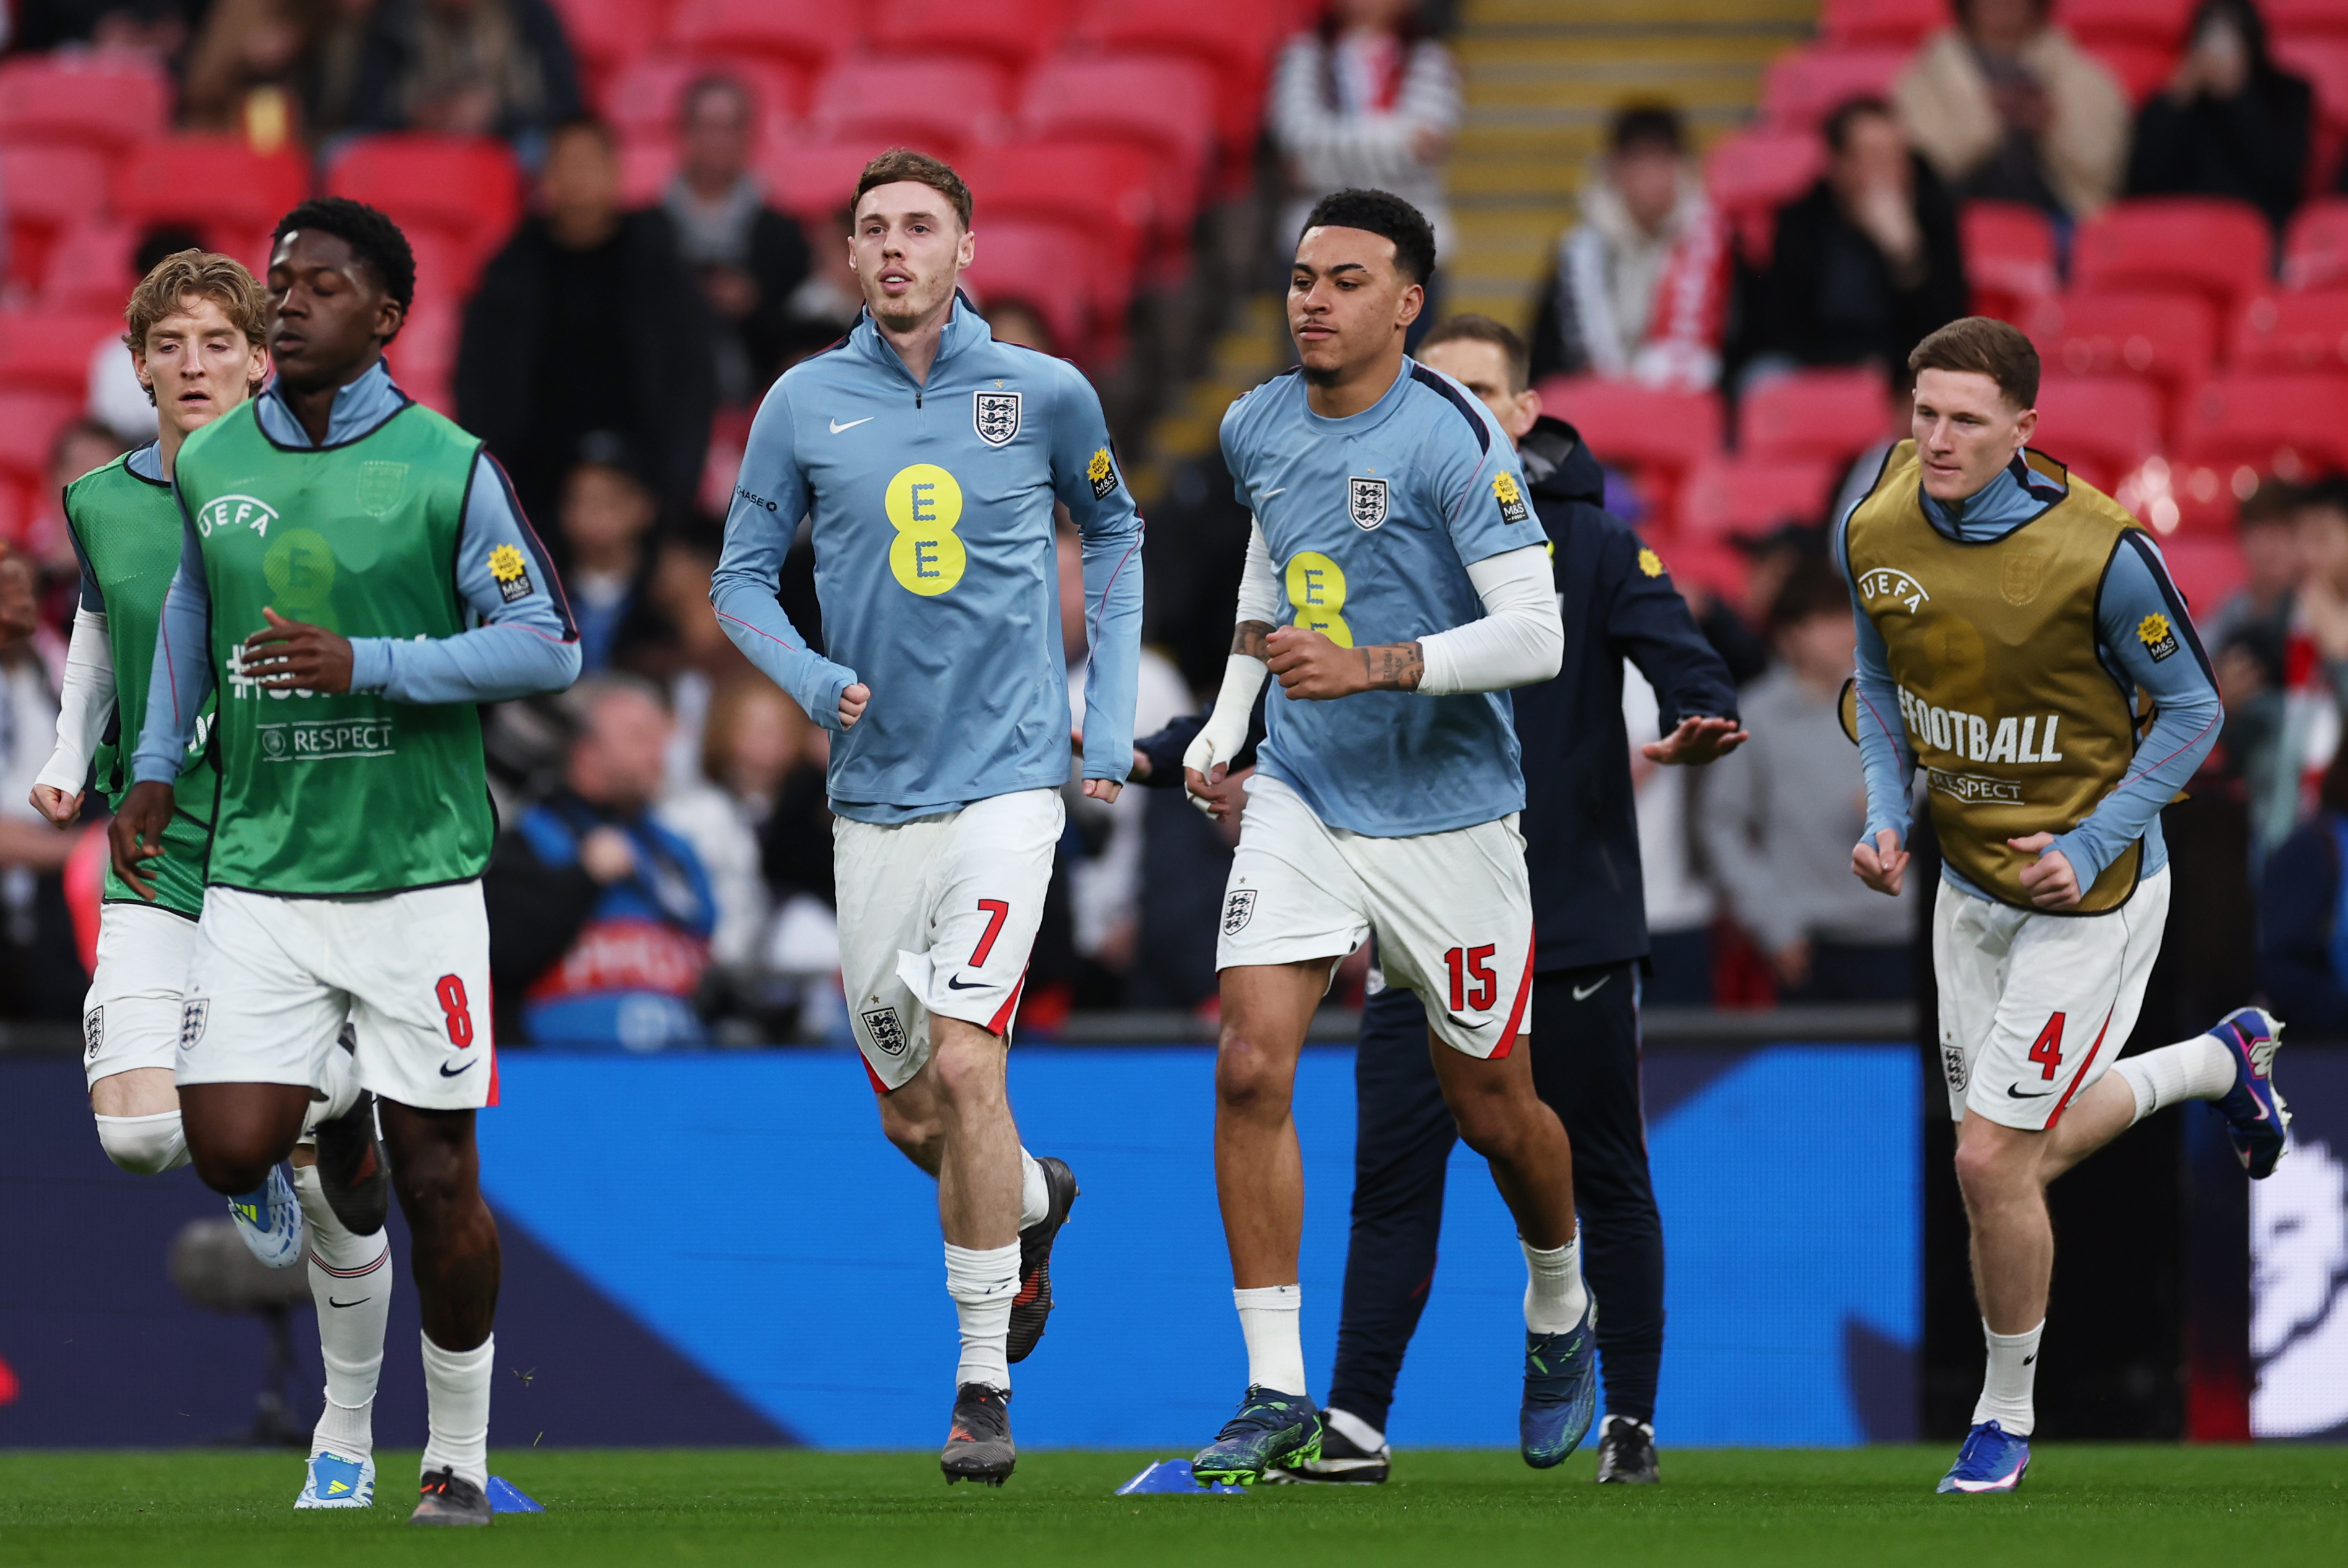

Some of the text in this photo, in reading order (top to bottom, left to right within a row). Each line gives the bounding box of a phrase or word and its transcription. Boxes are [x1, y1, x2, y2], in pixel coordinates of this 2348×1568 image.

[737, 485, 765, 507] CHASE
[1096, 473, 1114, 494] M&S
[199, 503, 270, 538] UEFA
[1504, 503, 1524, 517] M&S
[502, 576, 529, 597] M&S
[1862, 574, 1921, 613] UEFA
[2151, 637, 2174, 656] M&S
[294, 726, 392, 752] RESPECT
[1932, 773, 2021, 799] RESPECT
[968, 899, 1009, 968] 7
[1444, 943, 1496, 1011] 15
[435, 973, 474, 1050] 8
[2028, 1011, 2066, 1081] 4
